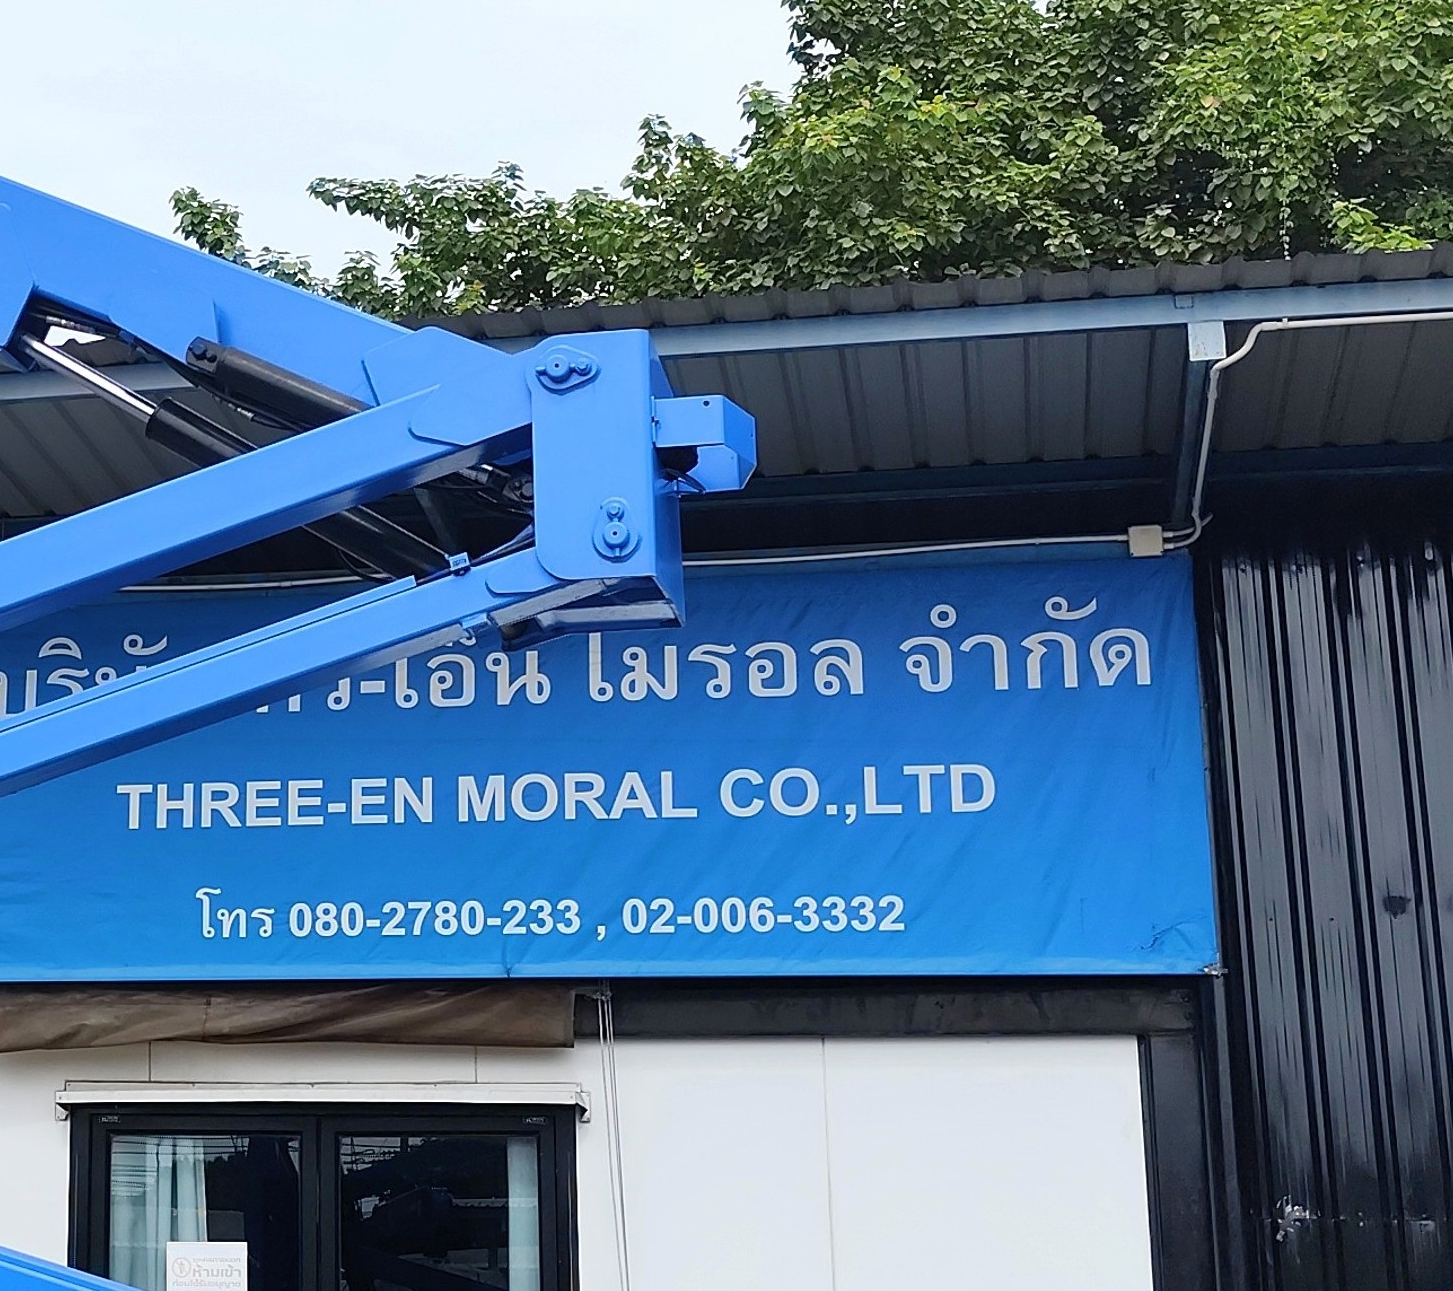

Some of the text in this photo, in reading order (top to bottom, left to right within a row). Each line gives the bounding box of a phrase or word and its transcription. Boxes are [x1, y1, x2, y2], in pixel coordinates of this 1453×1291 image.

[899, 595, 1152, 695] จำกัด
[115, 763, 997, 831] THREE-EN MORAL CO.,LTD
[195, 886, 275, 939] โทร
[288, 898, 581, 938] 080-2780-233
[622, 894, 906, 935] 02-006-3332
[192, 1264, 242, 1278] ห้ามเข้า
